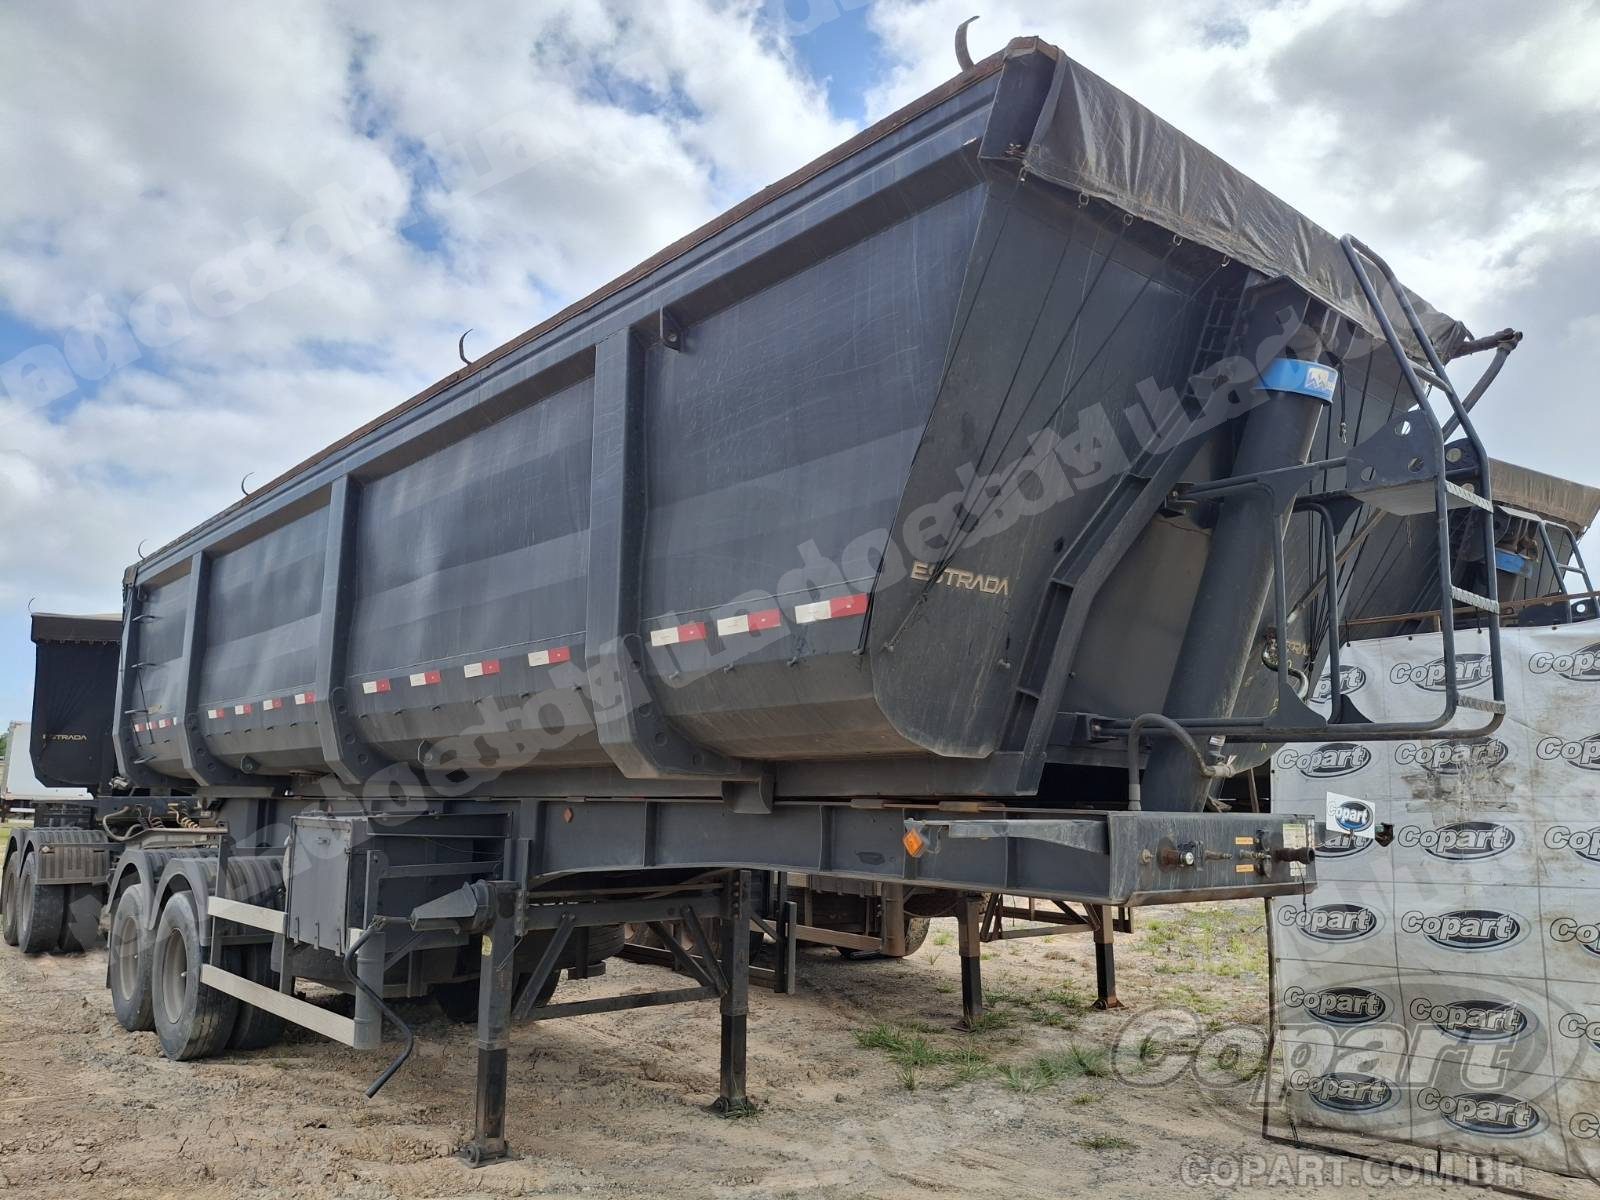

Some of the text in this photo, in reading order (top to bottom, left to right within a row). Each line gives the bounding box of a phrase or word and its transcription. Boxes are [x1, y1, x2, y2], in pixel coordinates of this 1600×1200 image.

[1276, 744, 1366, 773] Copart
[1394, 738, 1501, 768] Copart
[1327, 801, 1368, 826] Copart
[1397, 824, 1509, 853] Copart
[1277, 904, 1373, 933] Copart
[1400, 910, 1514, 940] Copart
[1284, 985, 1384, 1016] Copart
[1409, 997, 1523, 1033] Copart
[1289, 1069, 1390, 1103] Copart
[1417, 1086, 1532, 1127] Copart
